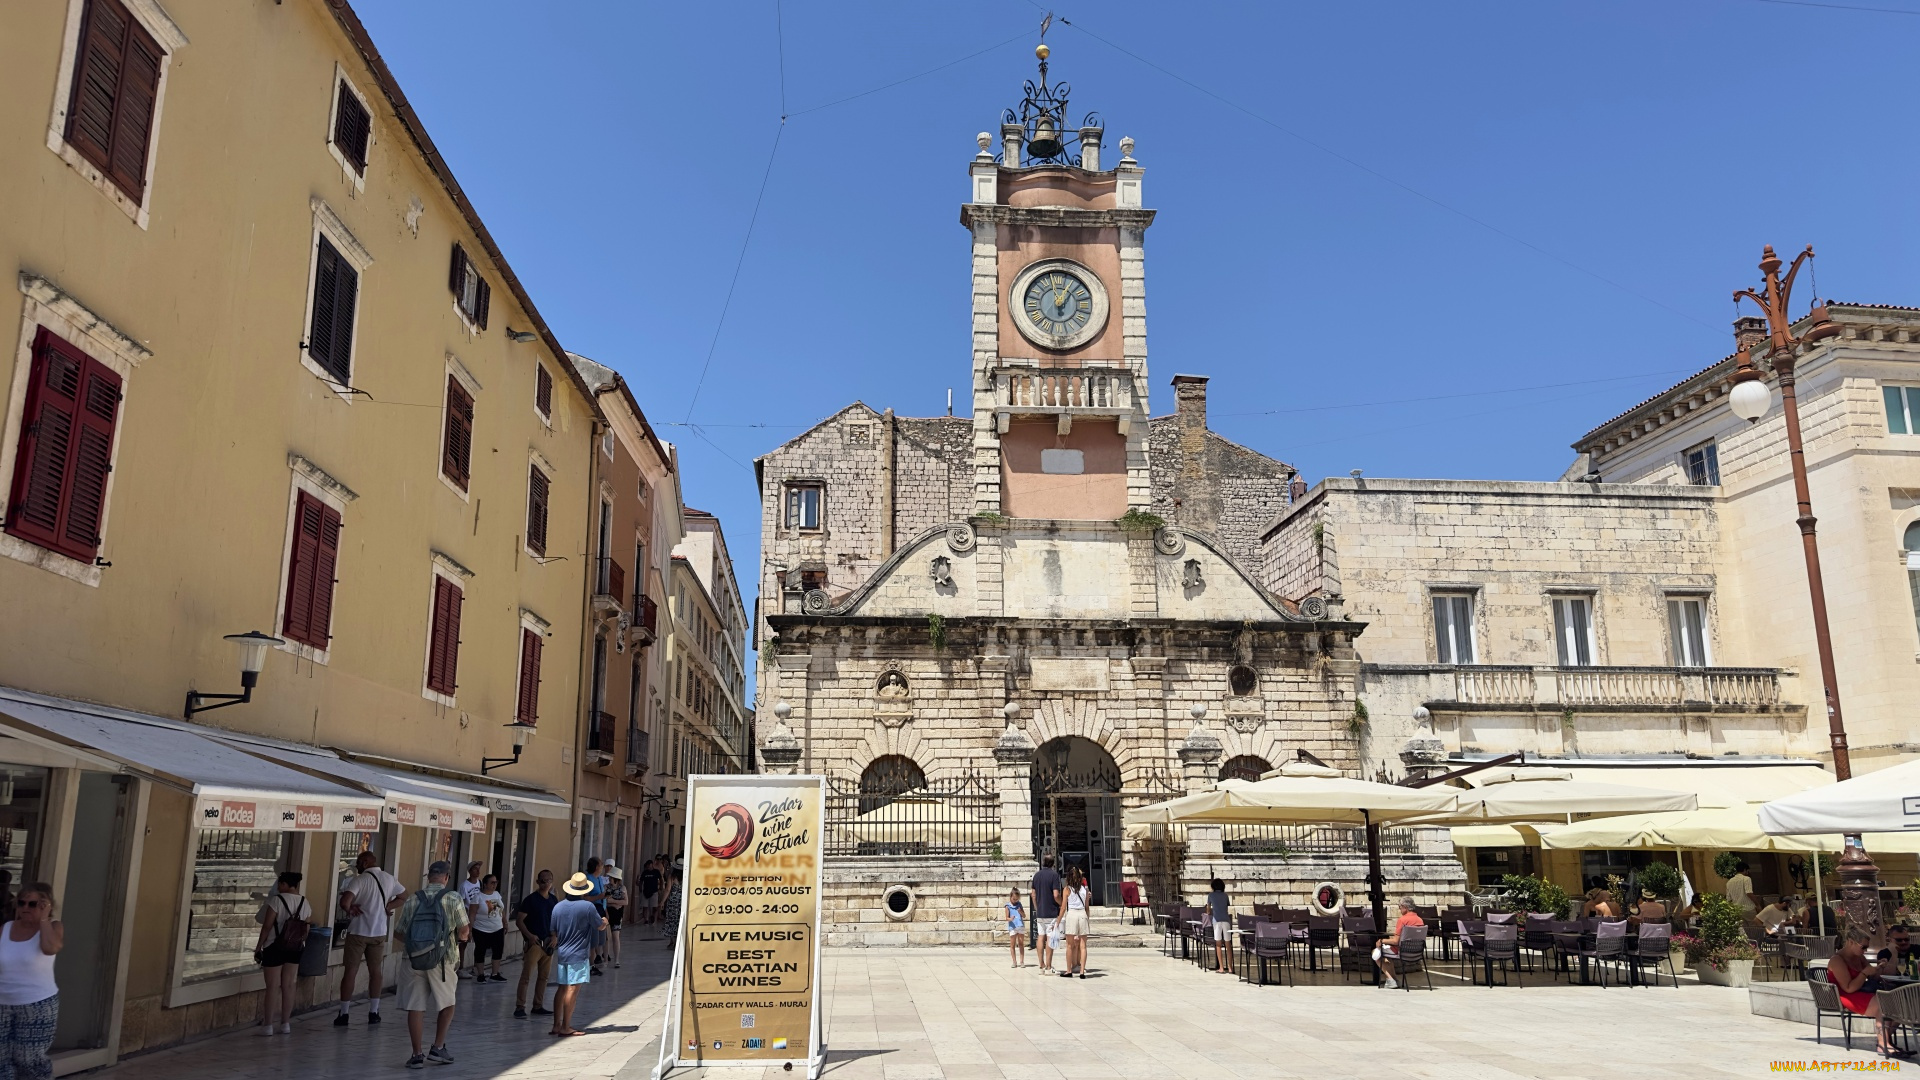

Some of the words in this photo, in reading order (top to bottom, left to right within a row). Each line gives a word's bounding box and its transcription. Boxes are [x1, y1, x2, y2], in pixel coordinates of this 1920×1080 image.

[204, 806, 220, 820] peko
[223, 806, 254, 824] Rodea
[282, 808, 295, 821] peko
[297, 808, 322, 825] Rodea
[398, 805, 415, 821] Rodea
[758, 796, 804, 824] Zadar
[342, 812, 355, 824] peko
[355, 812, 377, 827] Rodea
[762, 816, 793, 838] wine
[755, 829, 810, 863] festival
[698, 853, 815, 870] SUMMER
[694, 886, 764, 896] 02/03/04/05
[765, 886, 812, 895] AUGUST
[718, 904, 753, 914] 19:00
[762, 903, 799, 914] 24:00
[699, 931, 741, 942] LIVE
[744, 931, 804, 941] MUSIC
[726, 949, 776, 960] BEST
[702, 962, 798, 974] CROATIAN
[718, 976, 782, 987] WINES
[696, 1001, 724, 1009] ZADAR
[725, 1001, 744, 1009] CITY
